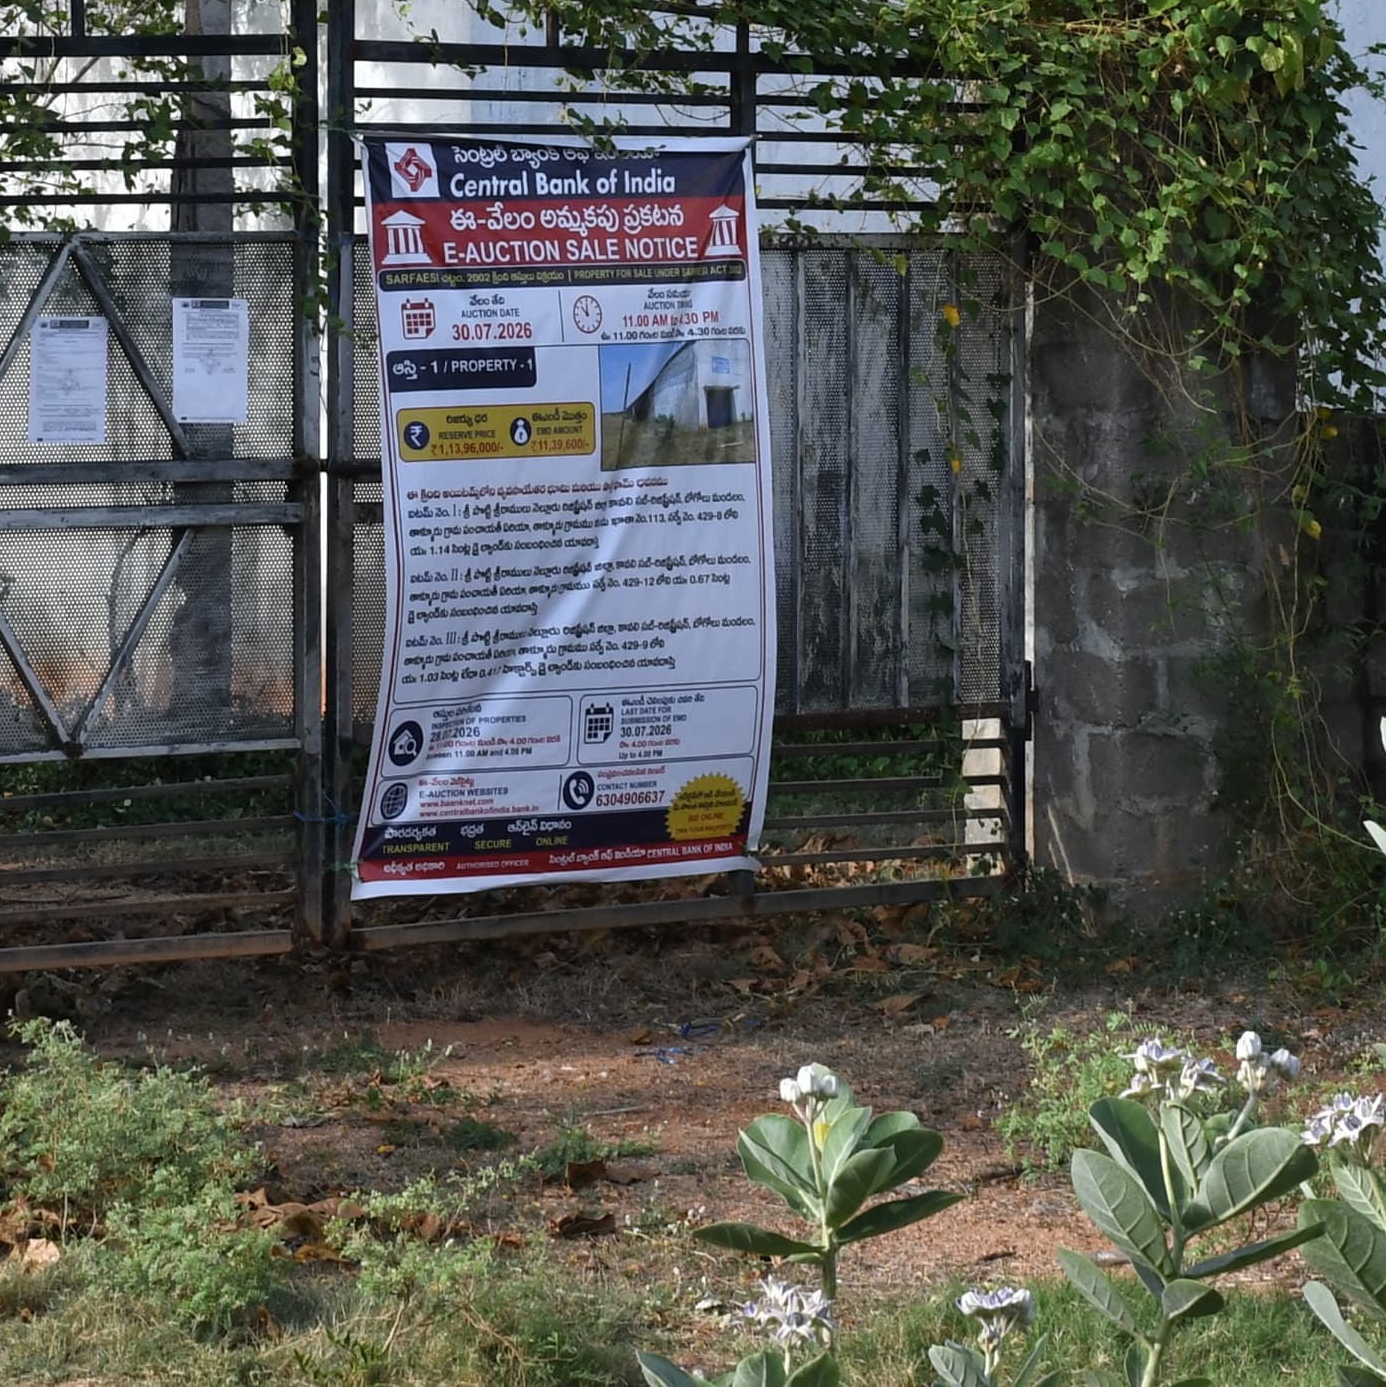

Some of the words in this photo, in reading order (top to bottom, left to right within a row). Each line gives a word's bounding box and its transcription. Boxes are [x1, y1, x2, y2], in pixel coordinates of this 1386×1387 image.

[450, 171, 529, 197] Central
[535, 169, 590, 196] Bank
[596, 168, 617, 195] of
[624, 167, 675, 194] India
[450, 202, 535, 231] ఈ-వేలం
[540, 204, 619, 237] అమ్మకపు
[623, 204, 684, 234] ప్రకటన
[443, 240, 560, 264] E-AUCTION
[566, 237, 620, 261] SALE
[625, 237, 699, 259] NOTICE
[386, 272, 439, 285] SARFAESI
[467, 273, 490, 283] 2002
[574, 268, 615, 280] PROPERTY
[616, 268, 631, 279] FOR
[634, 268, 653, 279] SALE
[655, 267, 680, 278] UNDER
[710, 264, 727, 275] ACT
[644, 301, 675, 311] AUCTION
[461, 308, 498, 319] AUCTION
[500, 307, 520, 318] DATE
[623, 315, 649, 328] 11.00
[652, 314, 668, 327] AM
[702, 310, 719, 323] PM
[452, 322, 532, 341] 30.07.2026
[613, 331, 638, 341] 11.00
[392, 359, 418, 380] ఆస్తి
[451, 358, 517, 373] PROPERTY
[438, 430, 473, 440] RESERVE
[475, 429, 496, 439] PRICE
[553, 425, 583, 435] AMOUNT
[430, 545, 450, 556] 1.14
[622, 575, 655, 587] 429-12
[690, 574, 710, 584] 0.67
[621, 640, 648, 651] 429-9
[420, 673, 439, 683] 1.03
[621, 707, 638, 716] LAST
[639, 706, 656, 715] DATE
[658, 706, 671, 714] FOR
[466, 716, 476, 725] OF
[478, 715, 526, 725] PROPERTIES
[620, 724, 672, 738] 30.07.2026
[596, 781, 628, 792] CONTACT
[629, 779, 657, 789] NUMBER
[419, 789, 465, 799] E-AUCTION
[466, 786, 509, 797] WEBSITES
[596, 789, 666, 807] 6304906637
[382, 841, 450, 855] TRANSPARENT
[474, 839, 512, 851] SECURE
[536, 836, 568, 847] ONLINE
[647, 846, 680, 860] CENTRAL
[682, 845, 702, 856] BANK
[703, 844, 712, 855] OF
[714, 842, 733, 853] INDIA
[501, 859, 530, 869] OFFICER
